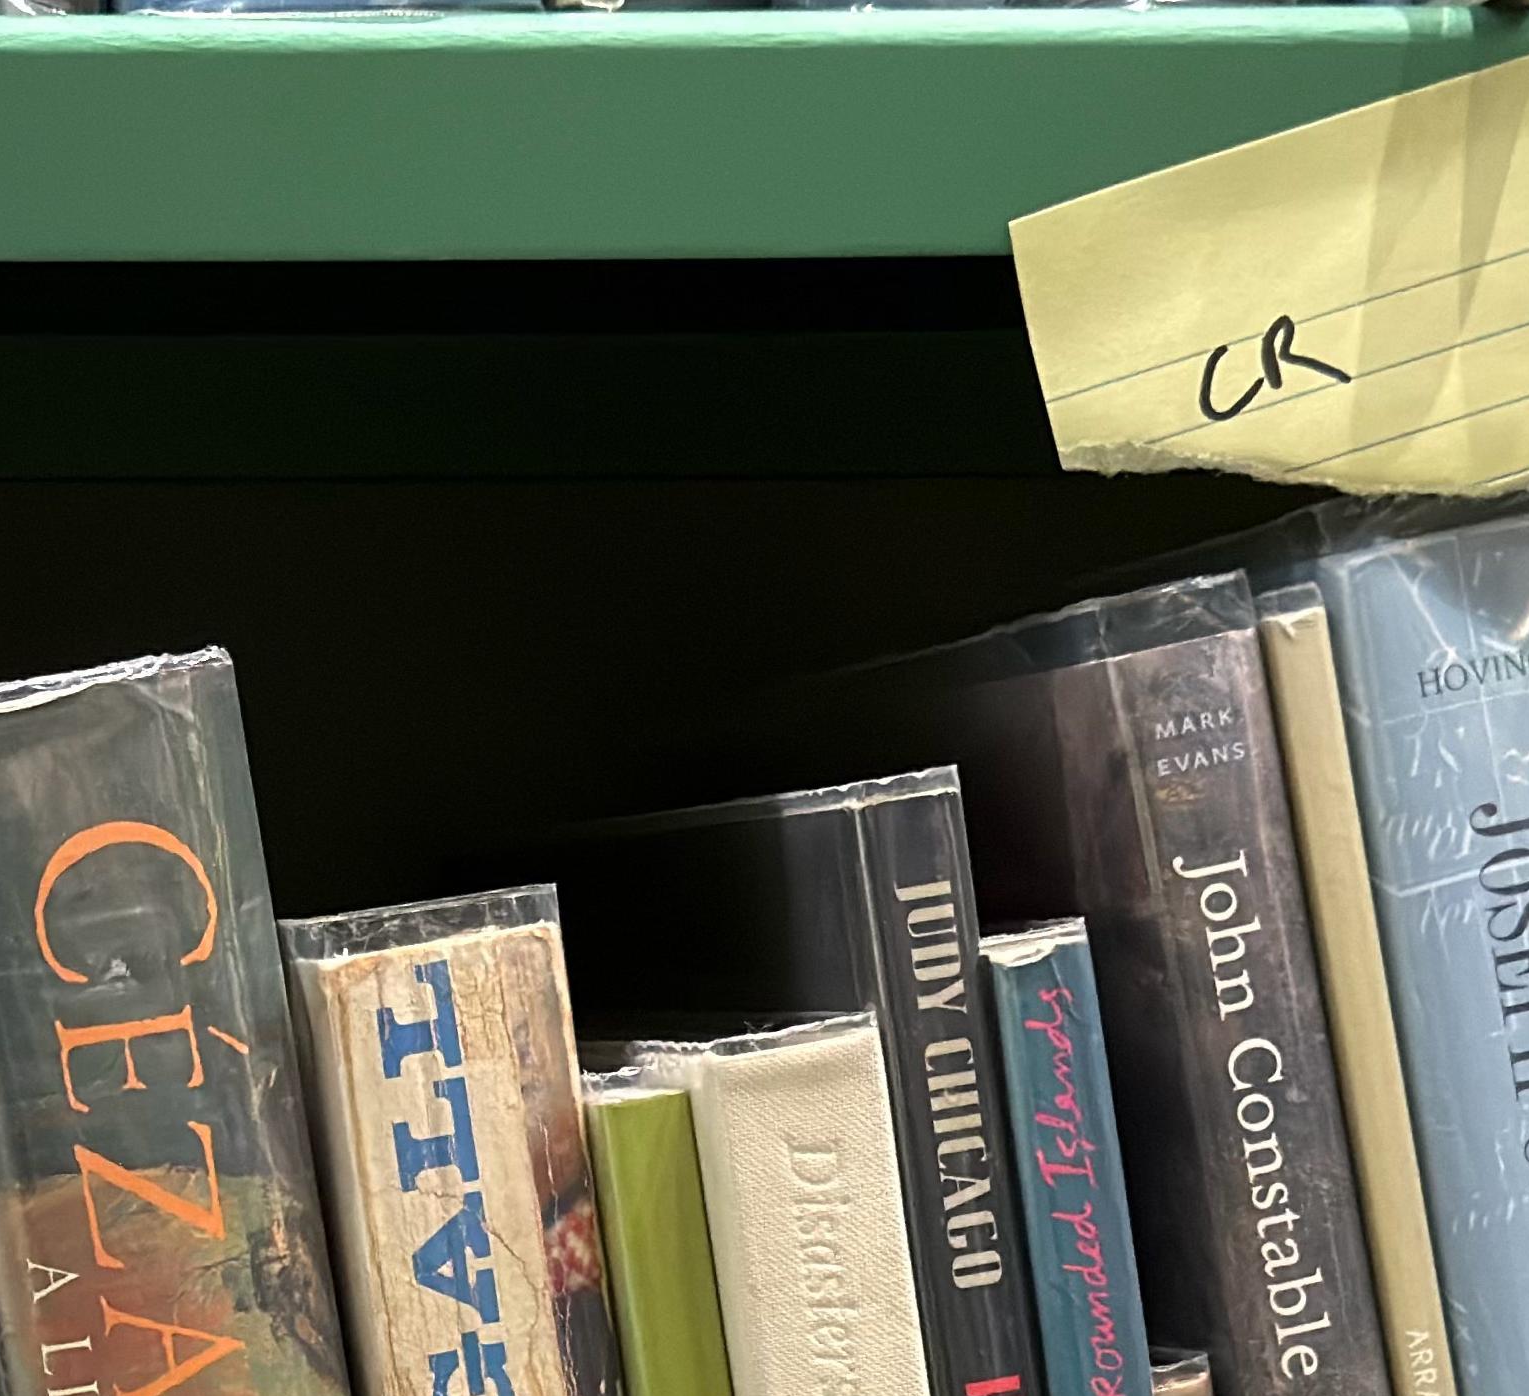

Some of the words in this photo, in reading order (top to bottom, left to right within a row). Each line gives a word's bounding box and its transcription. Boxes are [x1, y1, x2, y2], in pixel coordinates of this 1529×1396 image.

[1199, 315, 1352, 420] CR
[1154, 707, 1234, 741] MARK
[1156, 741, 1247, 778] EVANS
[894, 879, 969, 1015] JUDY
[923, 1035, 1003, 1290] CHICAGO
[1172, 848, 1263, 1022] John
[1227, 1036, 1332, 1380] Constable
[27, 1257, 80, 1303] A
